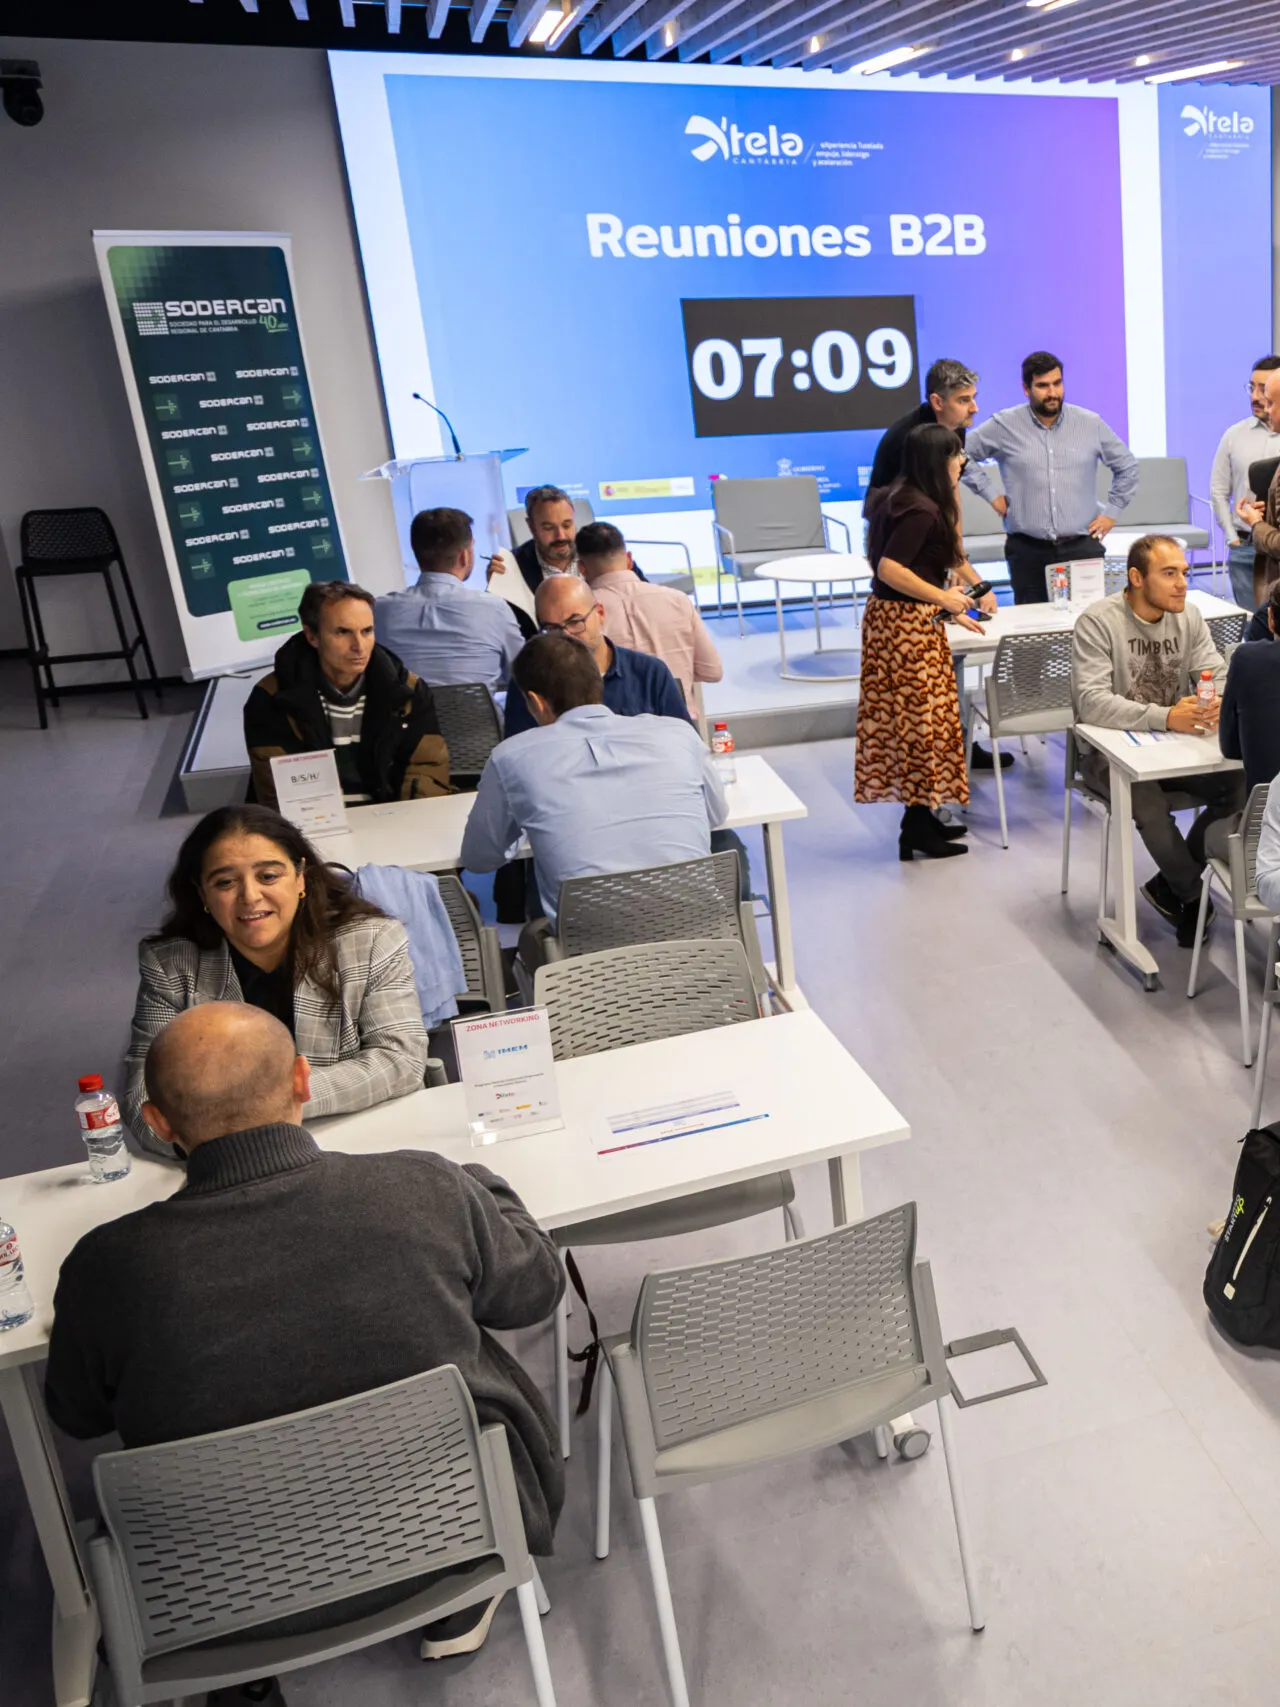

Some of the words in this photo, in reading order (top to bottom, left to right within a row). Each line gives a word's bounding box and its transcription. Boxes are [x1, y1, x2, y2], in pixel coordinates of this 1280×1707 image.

[733, 157, 798, 166] CANTABRIA
[587, 213, 871, 258] Reuniones
[890, 213, 987, 256] B2B
[692, 328, 913, 400] 07:09
[466, 1023, 488, 1032] ZONA
[488, 1014, 540, 1028] NETWORKING
